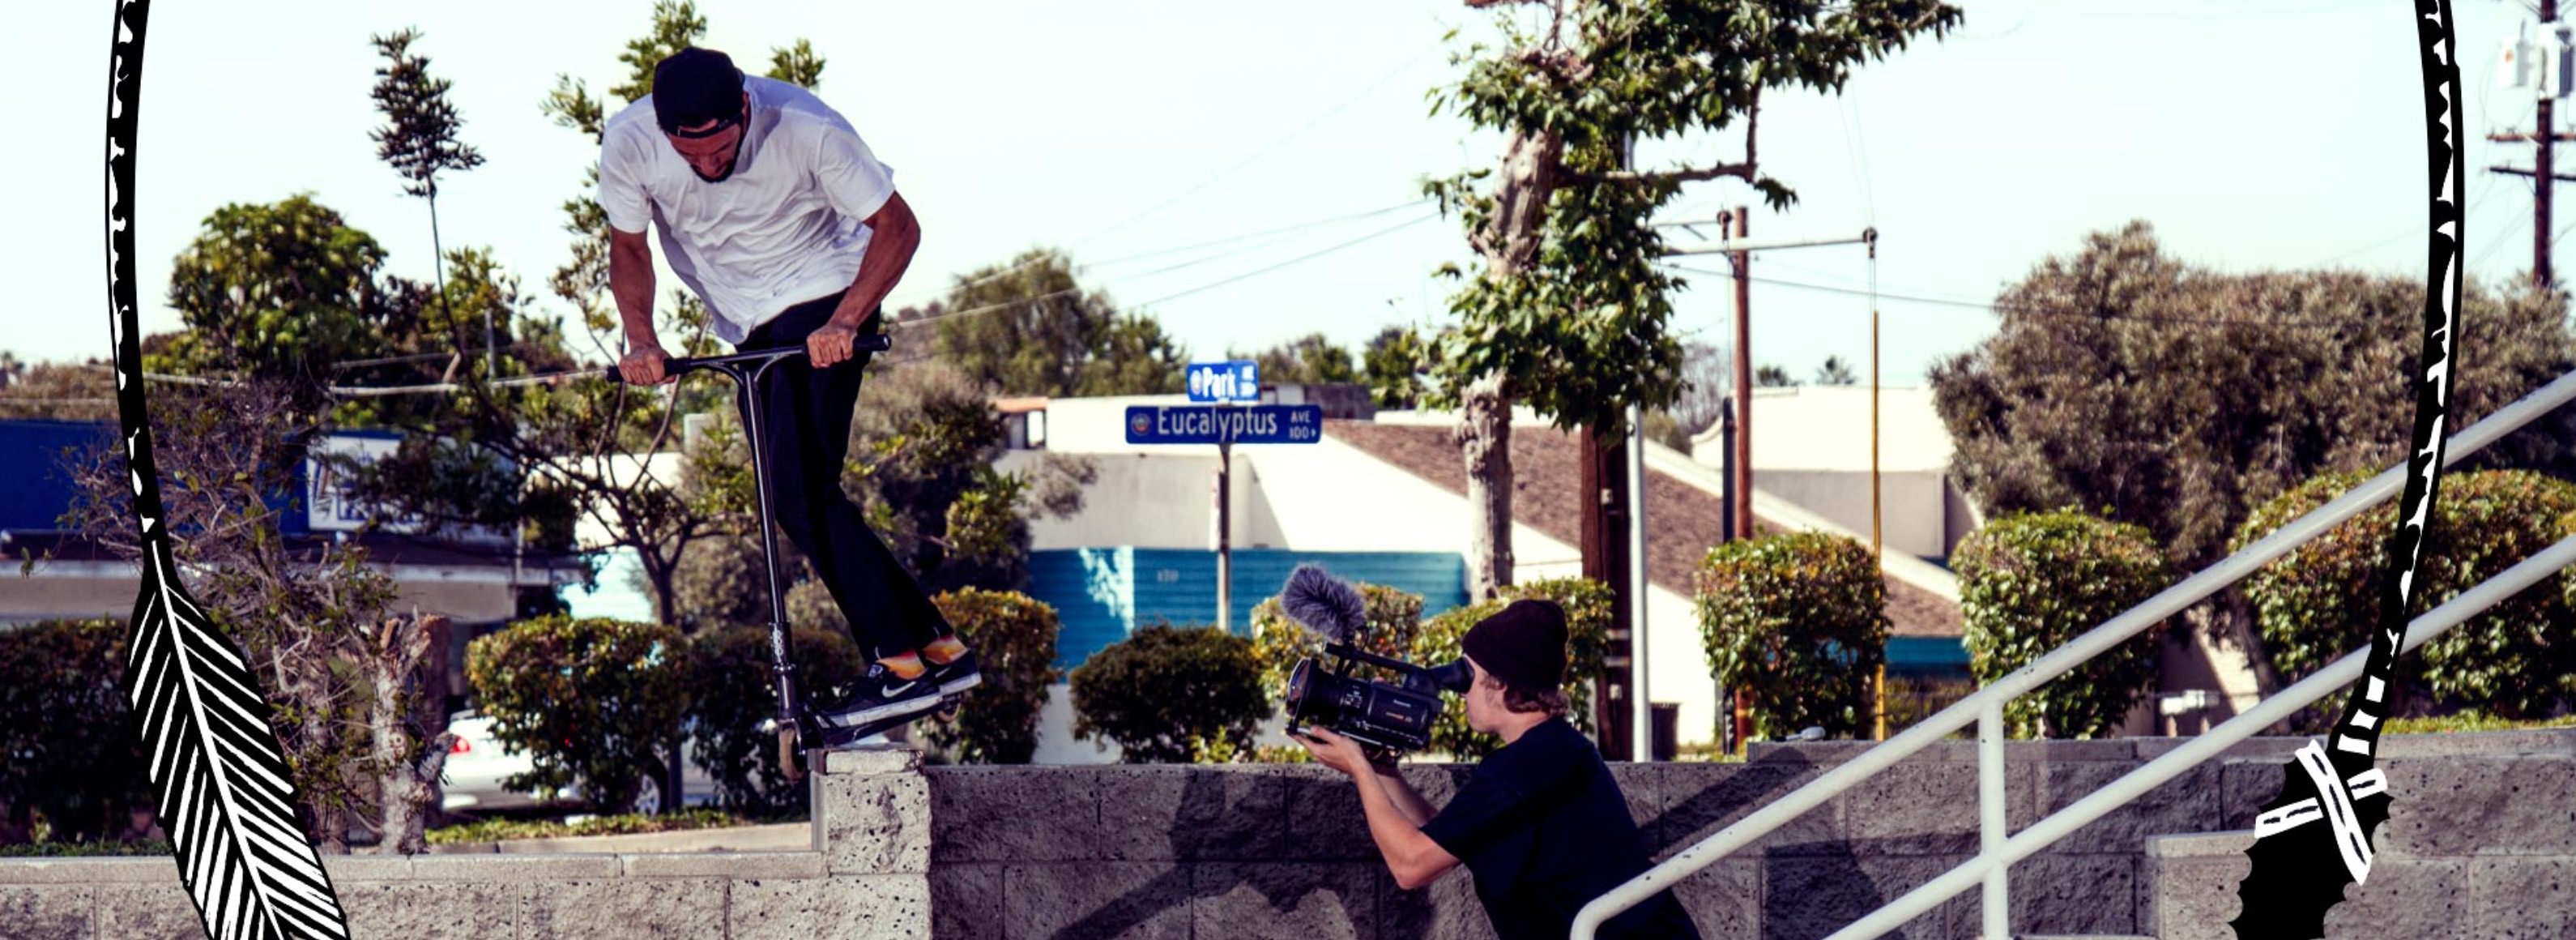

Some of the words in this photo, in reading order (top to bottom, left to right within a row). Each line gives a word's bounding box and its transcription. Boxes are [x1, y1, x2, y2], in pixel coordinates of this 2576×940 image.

[1202, 366, 1237, 398] Park
[1158, 408, 1277, 441] Eucalyptus
[1290, 410, 1311, 423] AVE
